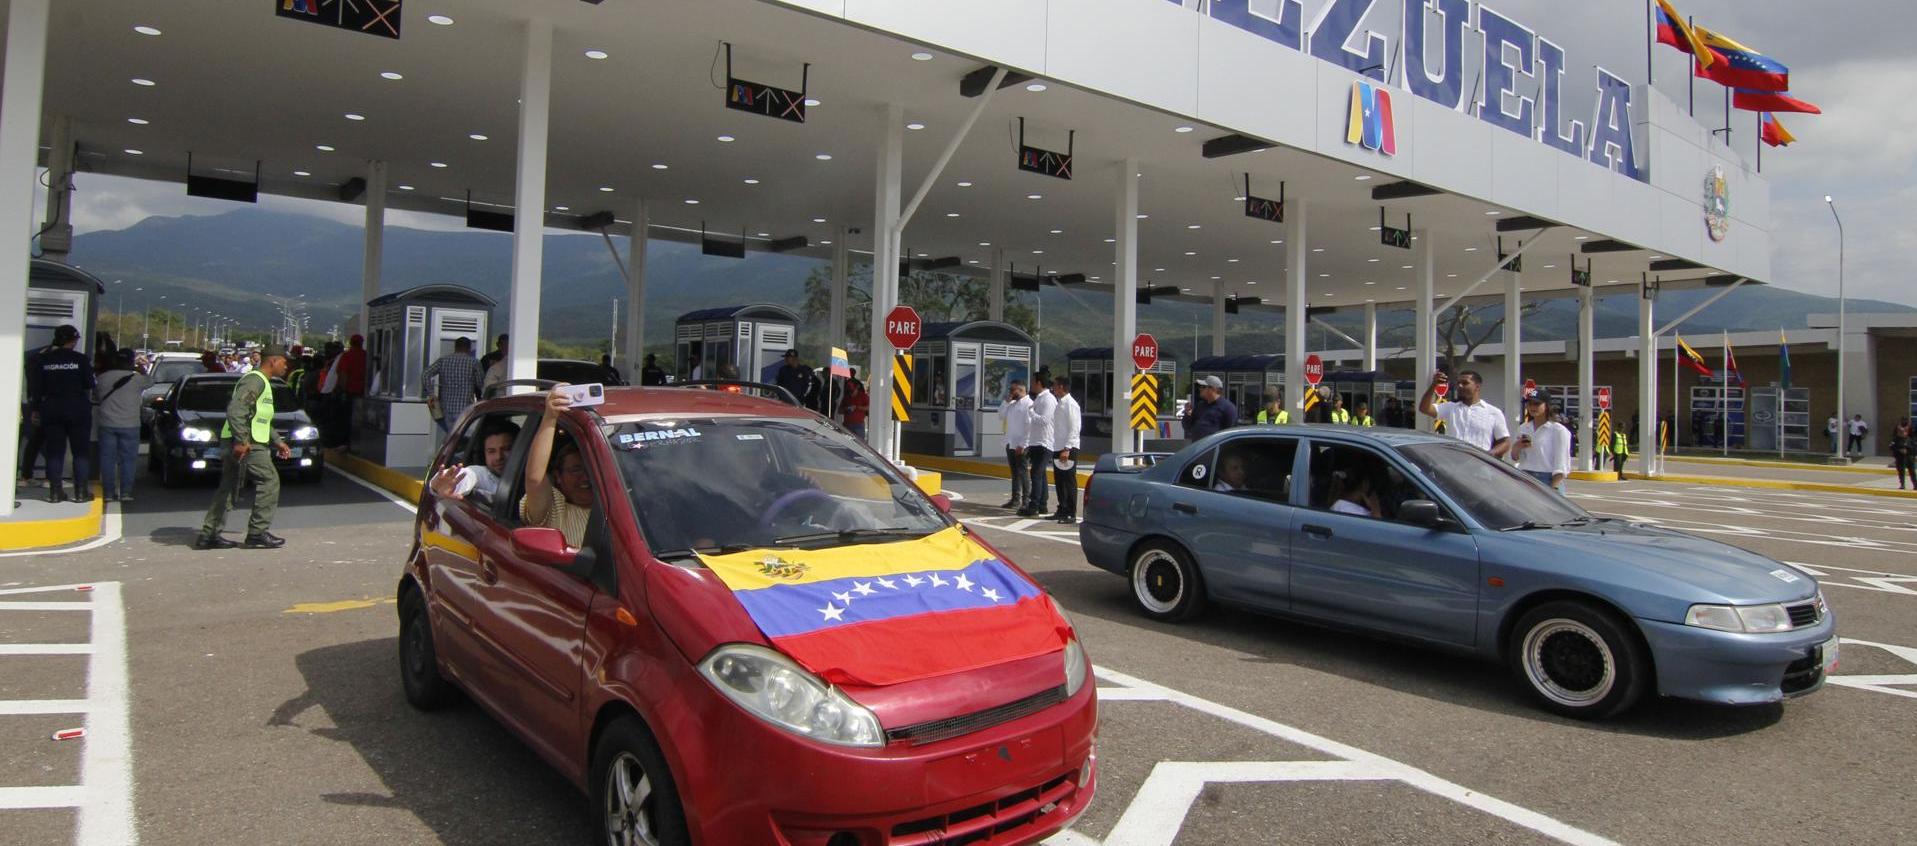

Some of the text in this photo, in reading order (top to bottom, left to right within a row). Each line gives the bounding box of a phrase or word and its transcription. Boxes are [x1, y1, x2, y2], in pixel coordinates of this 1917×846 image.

[1163, 0, 1650, 182] ZUELA
[889, 320, 916, 335] PARE
[1135, 346, 1156, 358] PARE
[1306, 364, 1321, 375] PARE
[619, 427, 702, 444] BERNAL
